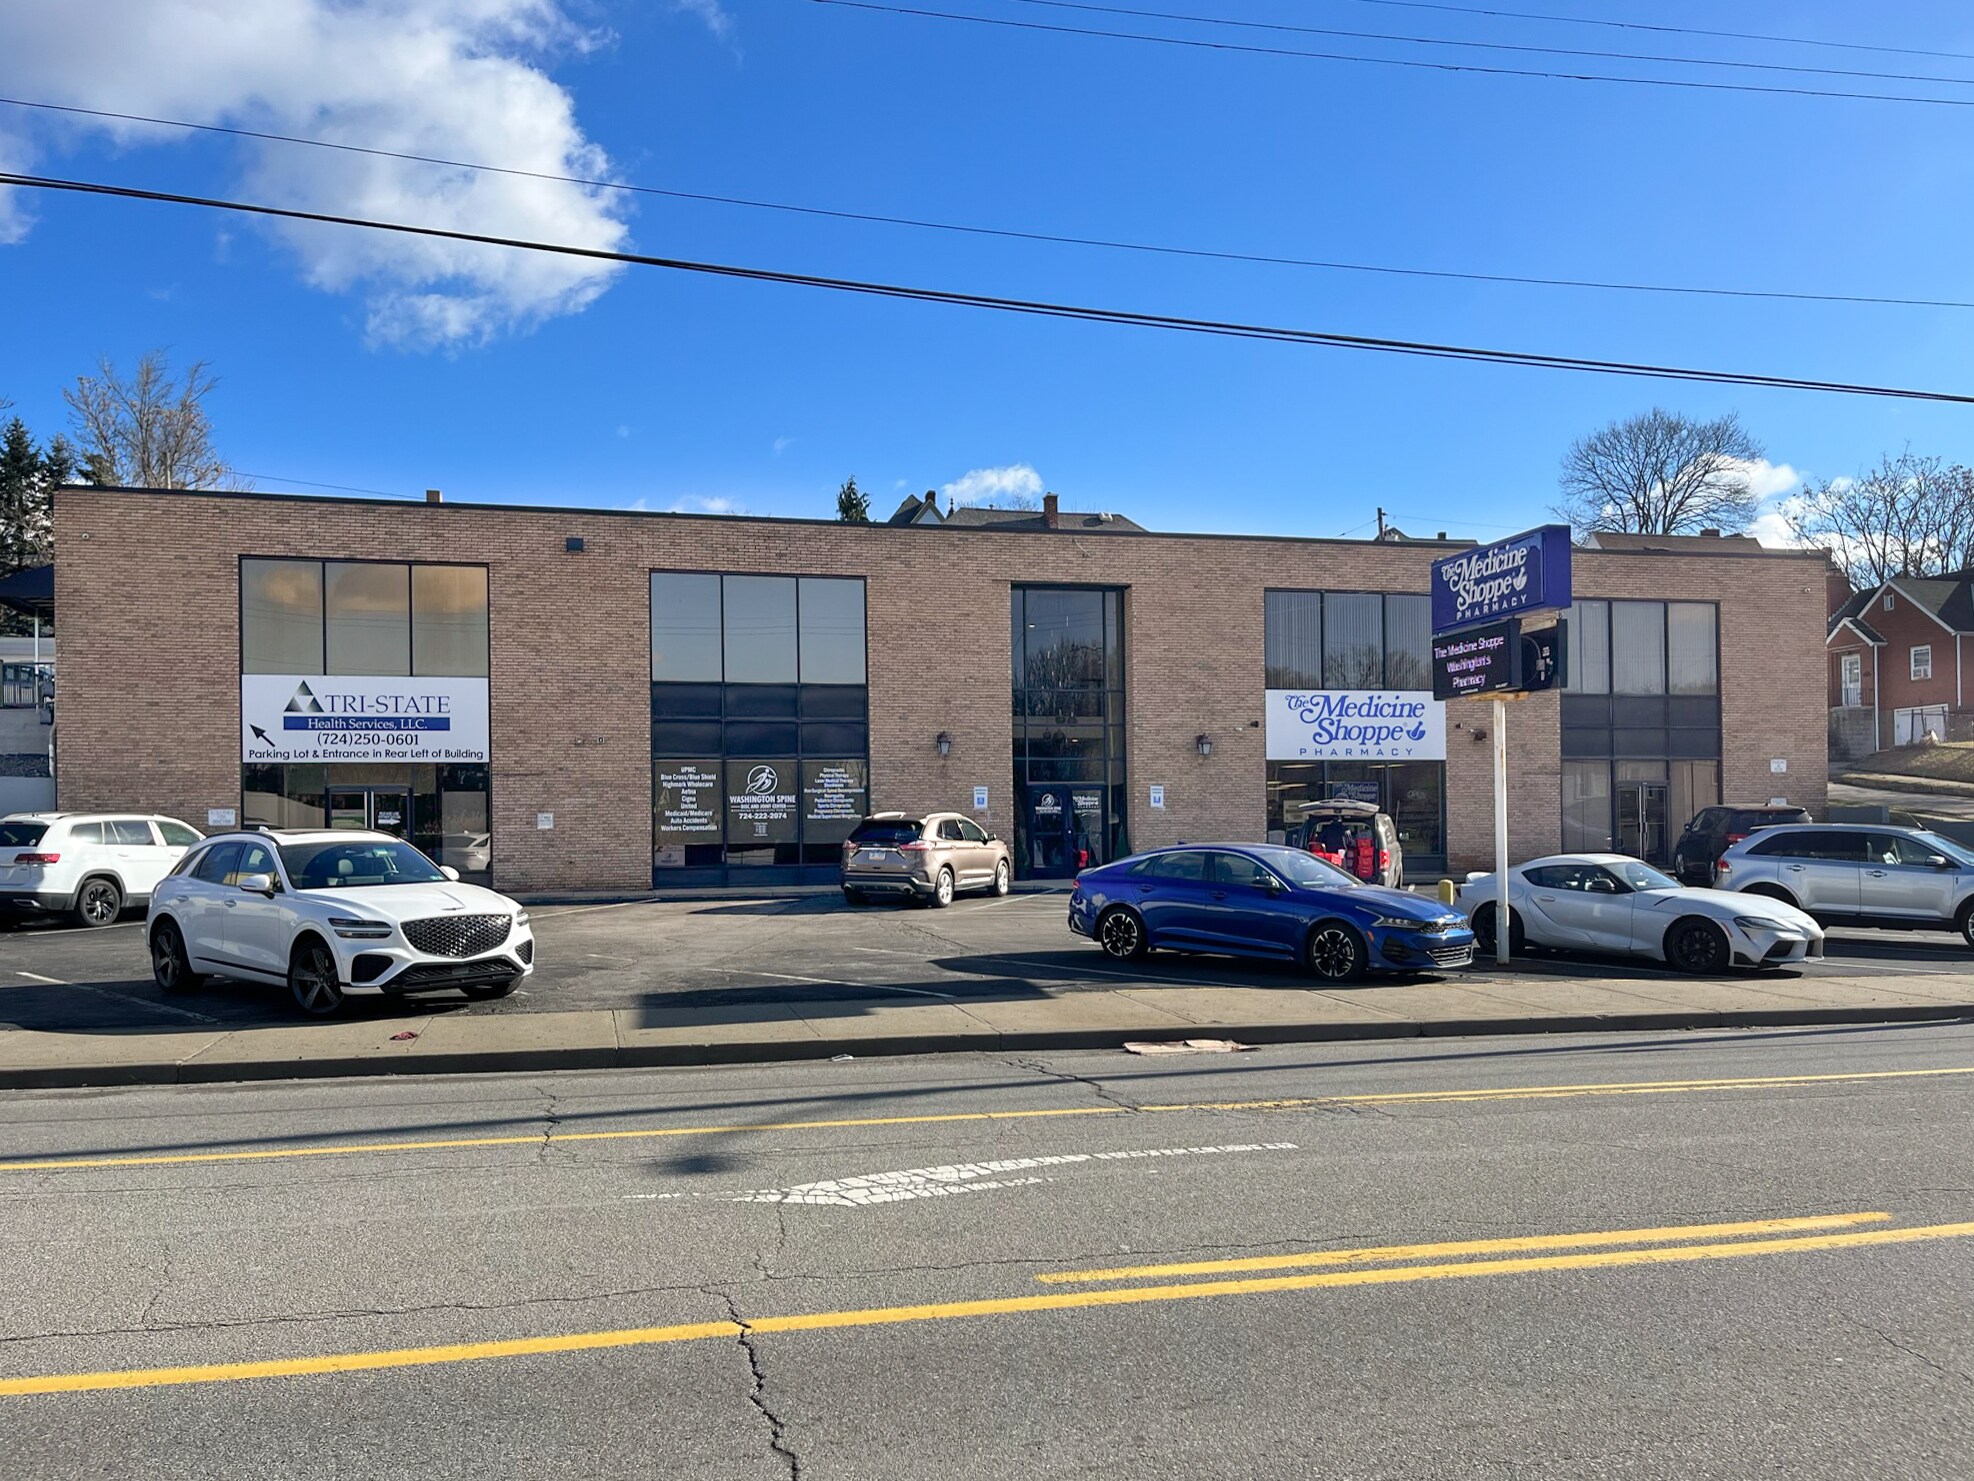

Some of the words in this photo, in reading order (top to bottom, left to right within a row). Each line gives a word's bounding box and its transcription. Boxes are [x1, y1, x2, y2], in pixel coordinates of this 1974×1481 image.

[1441, 562, 1456, 581] The
[1449, 544, 1527, 592] Medicine
[1457, 575, 1512, 611] Shoppe
[1457, 594, 1527, 621] PHARMACY
[1434, 648, 1447, 659] The
[1447, 641, 1477, 656] Medicine
[1478, 636, 1504, 651] Shoppe
[1452, 674, 1486, 688] Pharmacy
[325, 695, 451, 714] TRI-STATE
[1285, 695, 1309, 710] The
[1300, 694, 1425, 724] Medicine
[308, 717, 346, 730] Health
[350, 718, 397, 731] Services,
[401, 719, 428, 730] LLC.
[1312, 718, 1404, 745] Shoppe
[317, 732, 419, 747] (724)250-0601
[249, 749, 290, 760] Parking
[294, 749, 310, 759] Lot
[312, 750, 320, 759] &
[323, 749, 370, 759] Entrance
[373, 749, 382, 759] in
[385, 749, 407, 759] Rear
[411, 749, 430, 759] Left
[431, 749, 442, 759] of
[444, 749, 484, 761] Building
[1300, 748, 1413, 756] PHARMACY
[1342, 783, 1378, 793] Medicine
[729, 795, 775, 804] WASHINGTON
[777, 795, 796, 803] SPINE
[738, 812, 787, 820] 724-222-2074
